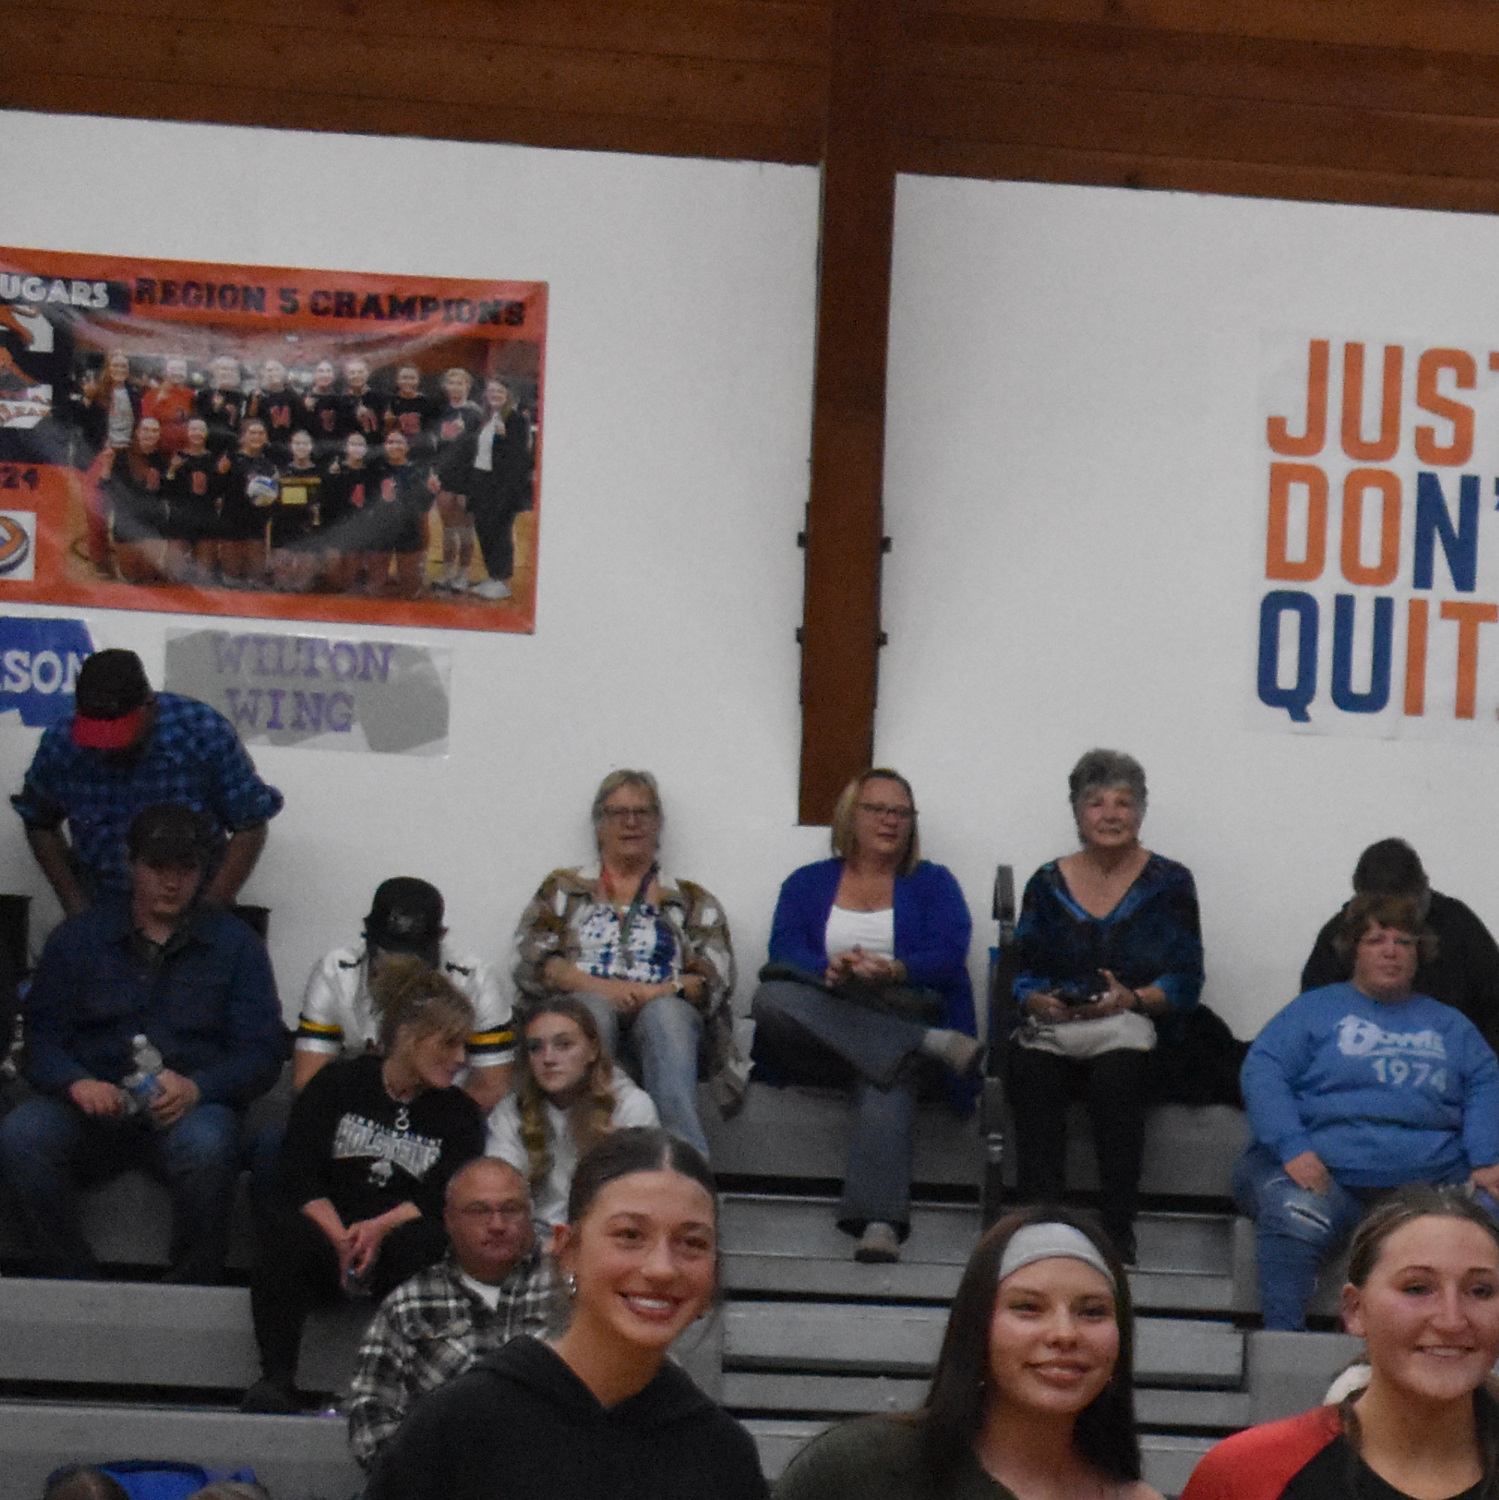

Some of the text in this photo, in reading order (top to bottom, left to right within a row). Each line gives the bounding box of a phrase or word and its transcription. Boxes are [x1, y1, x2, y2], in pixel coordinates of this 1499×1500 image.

[135, 277, 526, 327] REGION 5 CHAMPIONS
[212, 632, 394, 682] WILTON
[225, 690, 353, 732] WING
[1372, 1057, 1447, 1093] 1974
